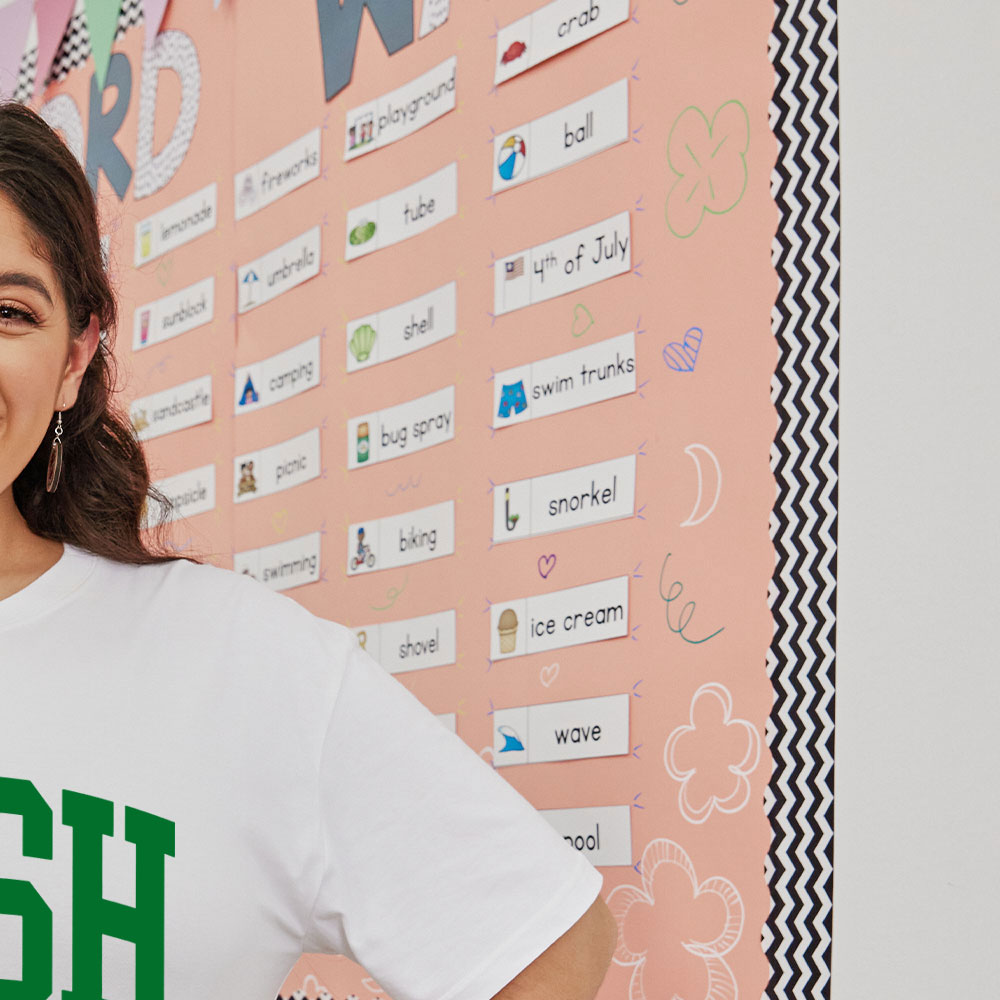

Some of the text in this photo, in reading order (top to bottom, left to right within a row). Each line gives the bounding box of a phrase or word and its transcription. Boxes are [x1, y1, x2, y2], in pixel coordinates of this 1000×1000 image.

[557, 3, 600, 38] crab
[377, 66, 456, 135] playground
[564, 111, 594, 149] ball
[260, 145, 318, 194] fireworks
[160, 200, 213, 241] lemonade
[403, 195, 436, 225] tube
[267, 246, 315, 288] umbrella
[533, 231, 630, 283] 4th of July
[161, 290, 208, 331] sunblock
[403, 306, 434, 341] shell
[269, 359, 315, 393] camping
[532, 352, 635, 400] swim trunks
[151, 388, 211, 423] sandcastle
[380, 410, 453, 449] bug spray
[275, 454, 308, 485] picnic
[548, 475, 618, 516] snorkel
[399, 525, 437, 554] biking
[262, 553, 317, 583] swimming
[530, 602, 624, 639] ice cream
[398, 628, 440, 660] shovel
[554, 723, 603, 746] wave
